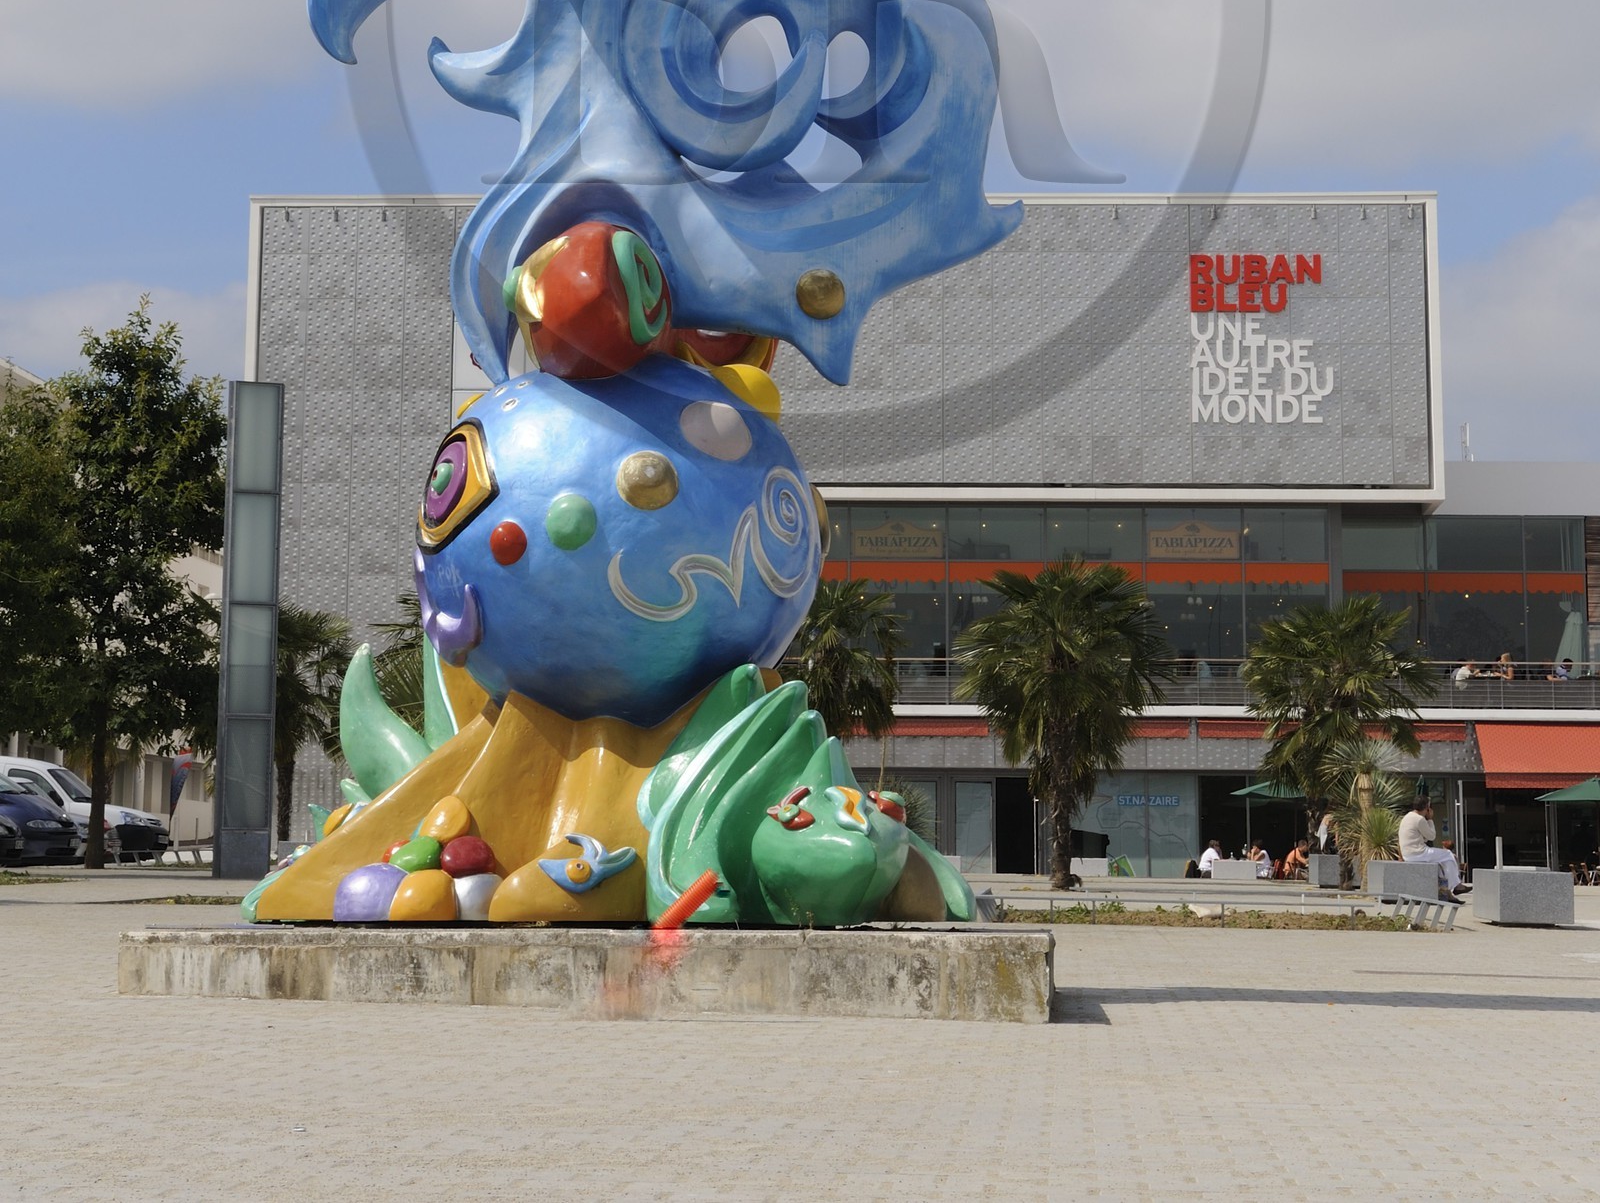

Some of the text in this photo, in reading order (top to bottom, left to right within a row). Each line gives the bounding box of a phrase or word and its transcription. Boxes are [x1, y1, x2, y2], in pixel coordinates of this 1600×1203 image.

[1190, 254, 1322, 284] RUBAN
[1190, 283, 1288, 312] BLEU
[1190, 312, 1266, 341] UNE
[1190, 339, 1314, 368] AUTRE
[1192, 359, 1334, 396] IDÉE DU
[1191, 394, 1323, 423] MONDE
